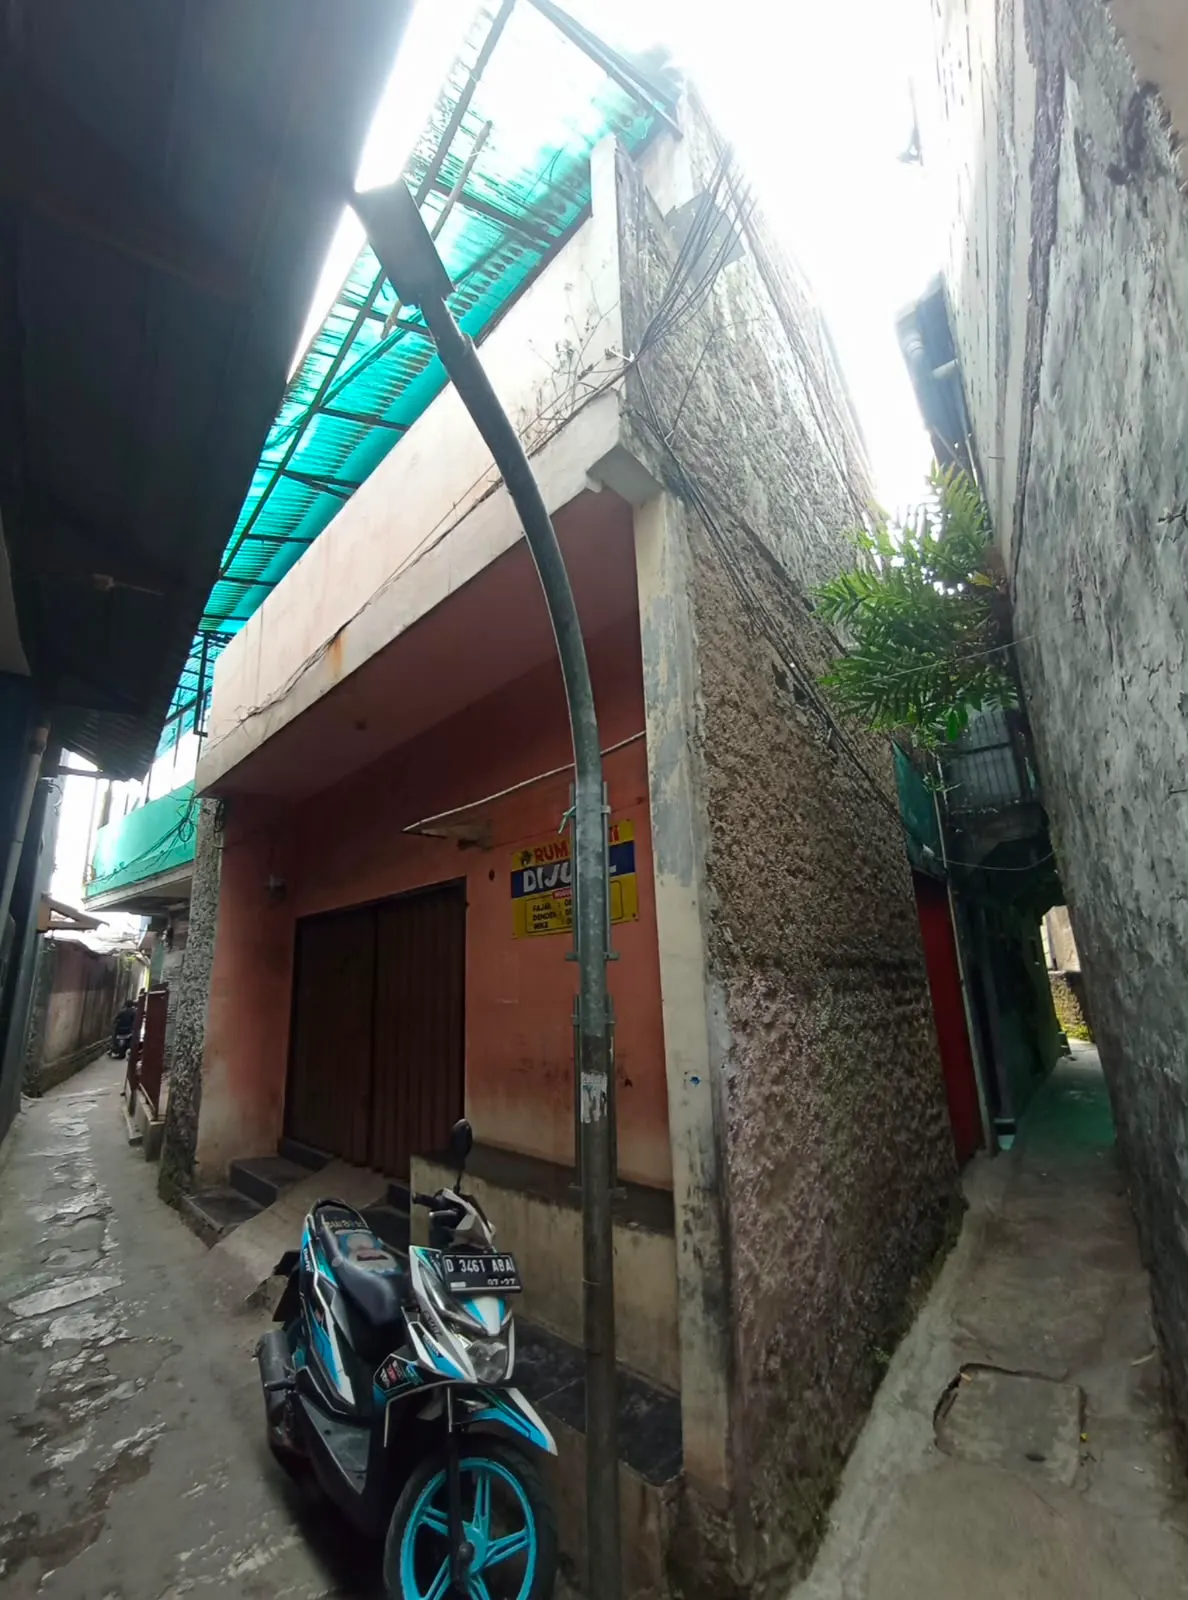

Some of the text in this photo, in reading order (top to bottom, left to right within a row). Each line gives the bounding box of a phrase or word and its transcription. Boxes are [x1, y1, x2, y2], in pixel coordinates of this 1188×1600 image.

[534, 840, 569, 862] RUM
[446, 1259, 454, 1272] D
[460, 1259, 485, 1272] 3461
